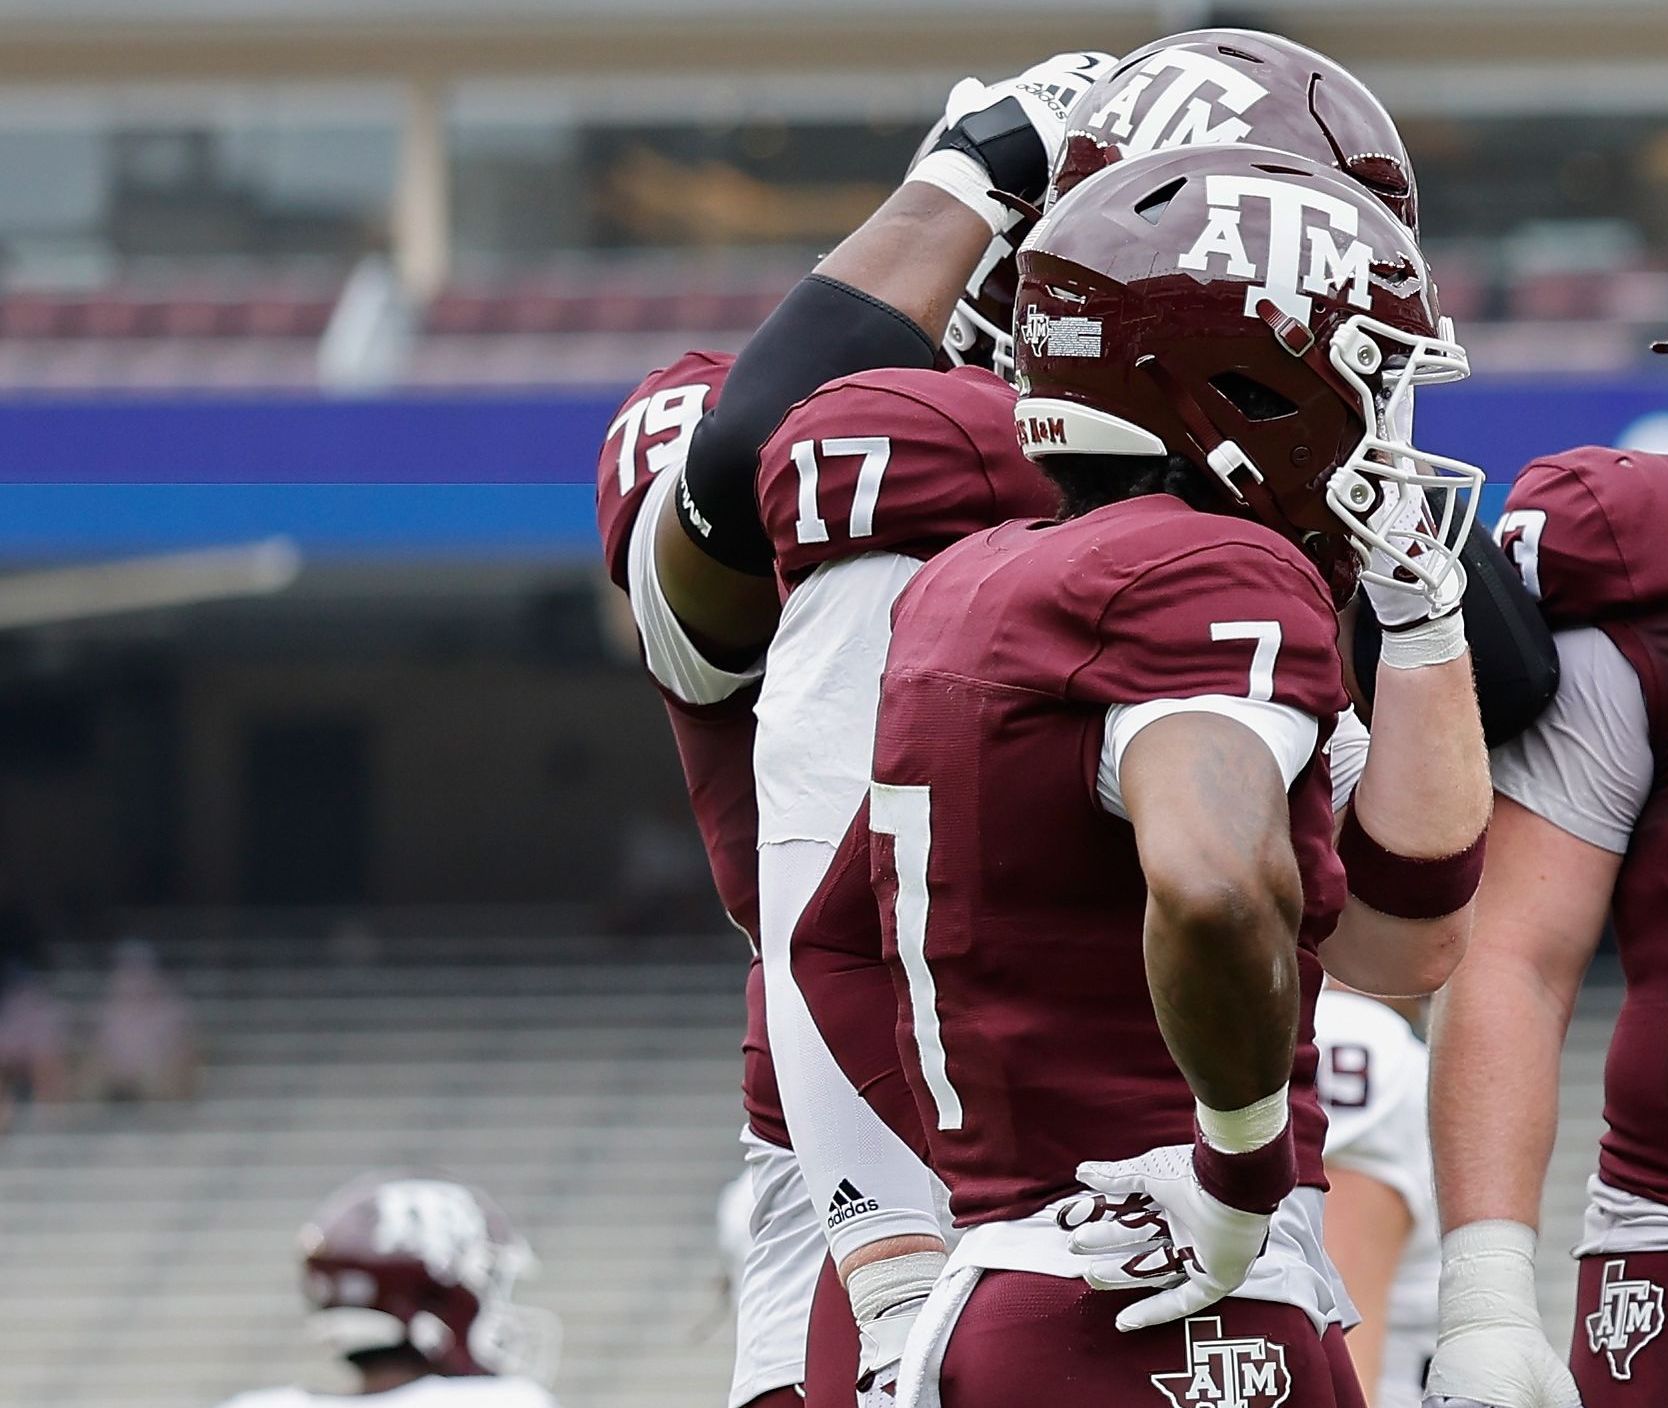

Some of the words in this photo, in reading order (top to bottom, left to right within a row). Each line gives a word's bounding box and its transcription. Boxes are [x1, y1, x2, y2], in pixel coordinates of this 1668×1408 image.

[607, 384, 711, 497] 79
[790, 435, 893, 545] 17
[1210, 620, 1282, 703] 7
[827, 1199, 879, 1229] adidas
